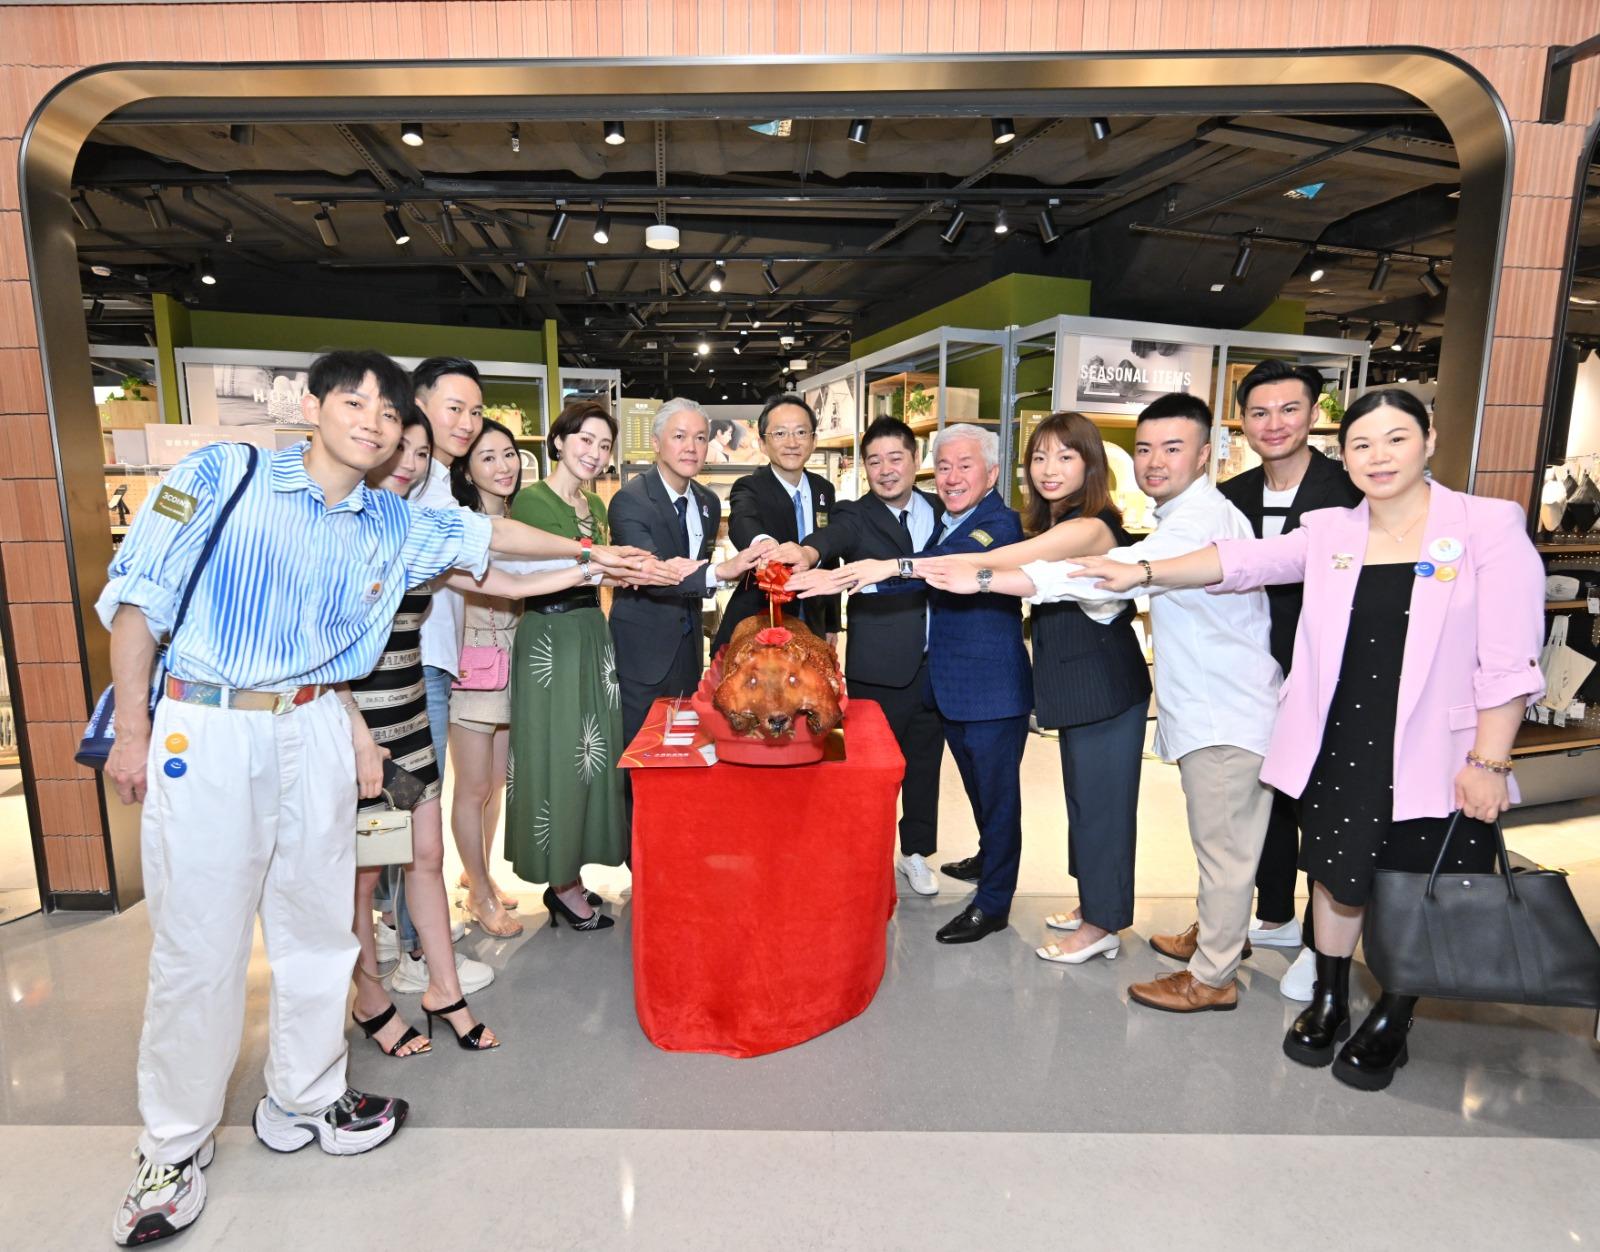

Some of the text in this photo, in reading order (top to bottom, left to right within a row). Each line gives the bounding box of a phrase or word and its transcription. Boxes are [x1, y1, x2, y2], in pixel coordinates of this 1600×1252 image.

[1080, 364, 1192, 386] SEASONAL ITEMS
[253, 388, 302, 403] HOM
